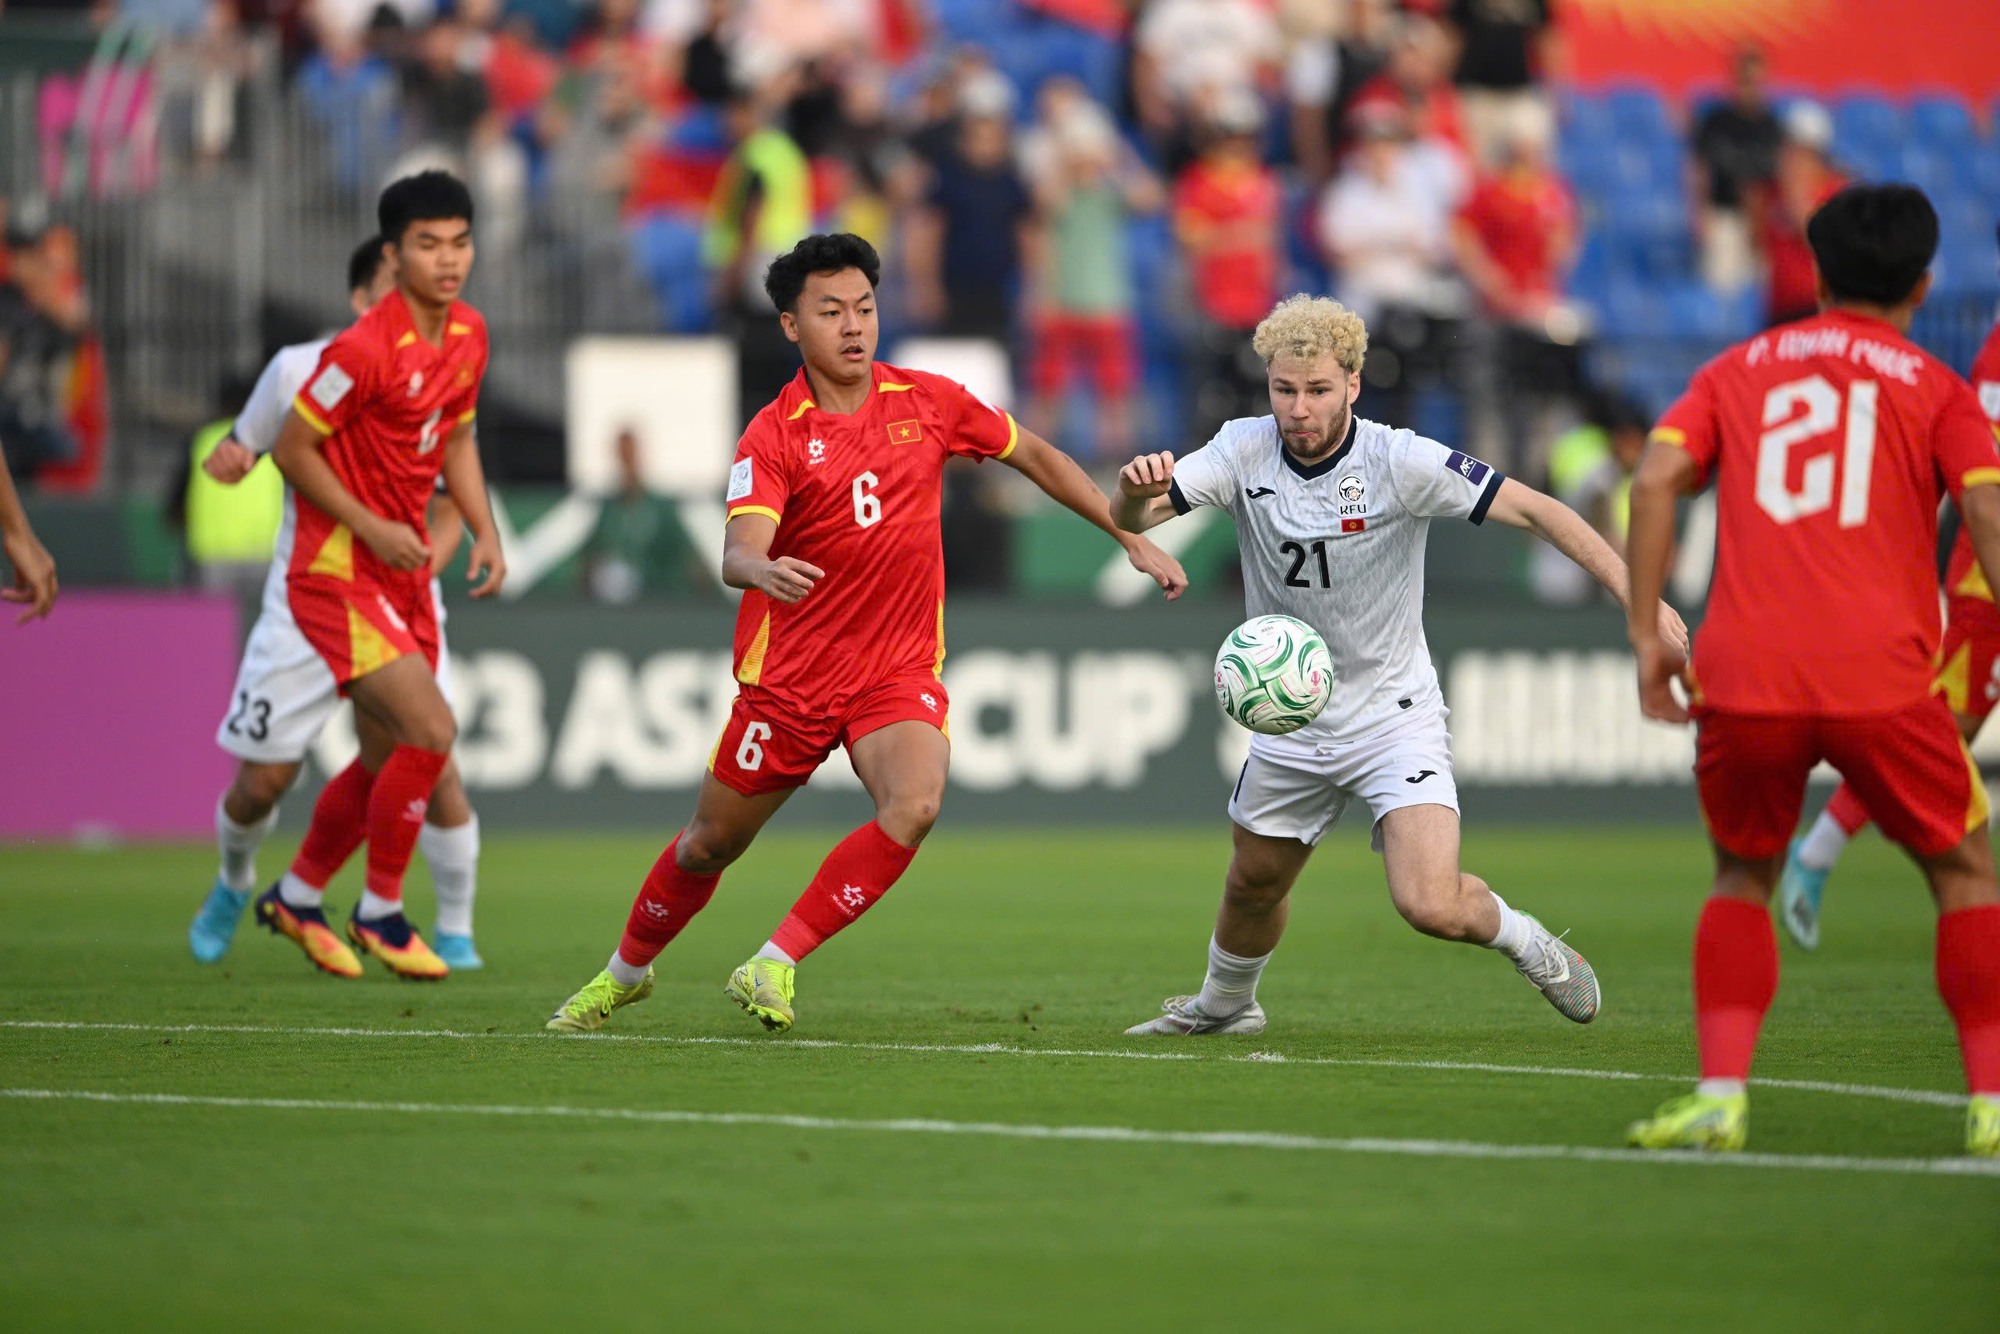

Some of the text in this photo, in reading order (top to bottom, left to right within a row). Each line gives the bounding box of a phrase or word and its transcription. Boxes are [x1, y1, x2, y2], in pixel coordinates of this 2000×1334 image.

[1459, 457, 1474, 476] AFC
[1755, 373, 1880, 528] 21
[851, 470, 882, 528] 6
[1339, 504, 1368, 515] KFU
[1279, 540, 1331, 589] 21
[227, 687, 272, 742] 23
[944, 648, 1190, 789] CUP
[735, 720, 773, 772] 6
